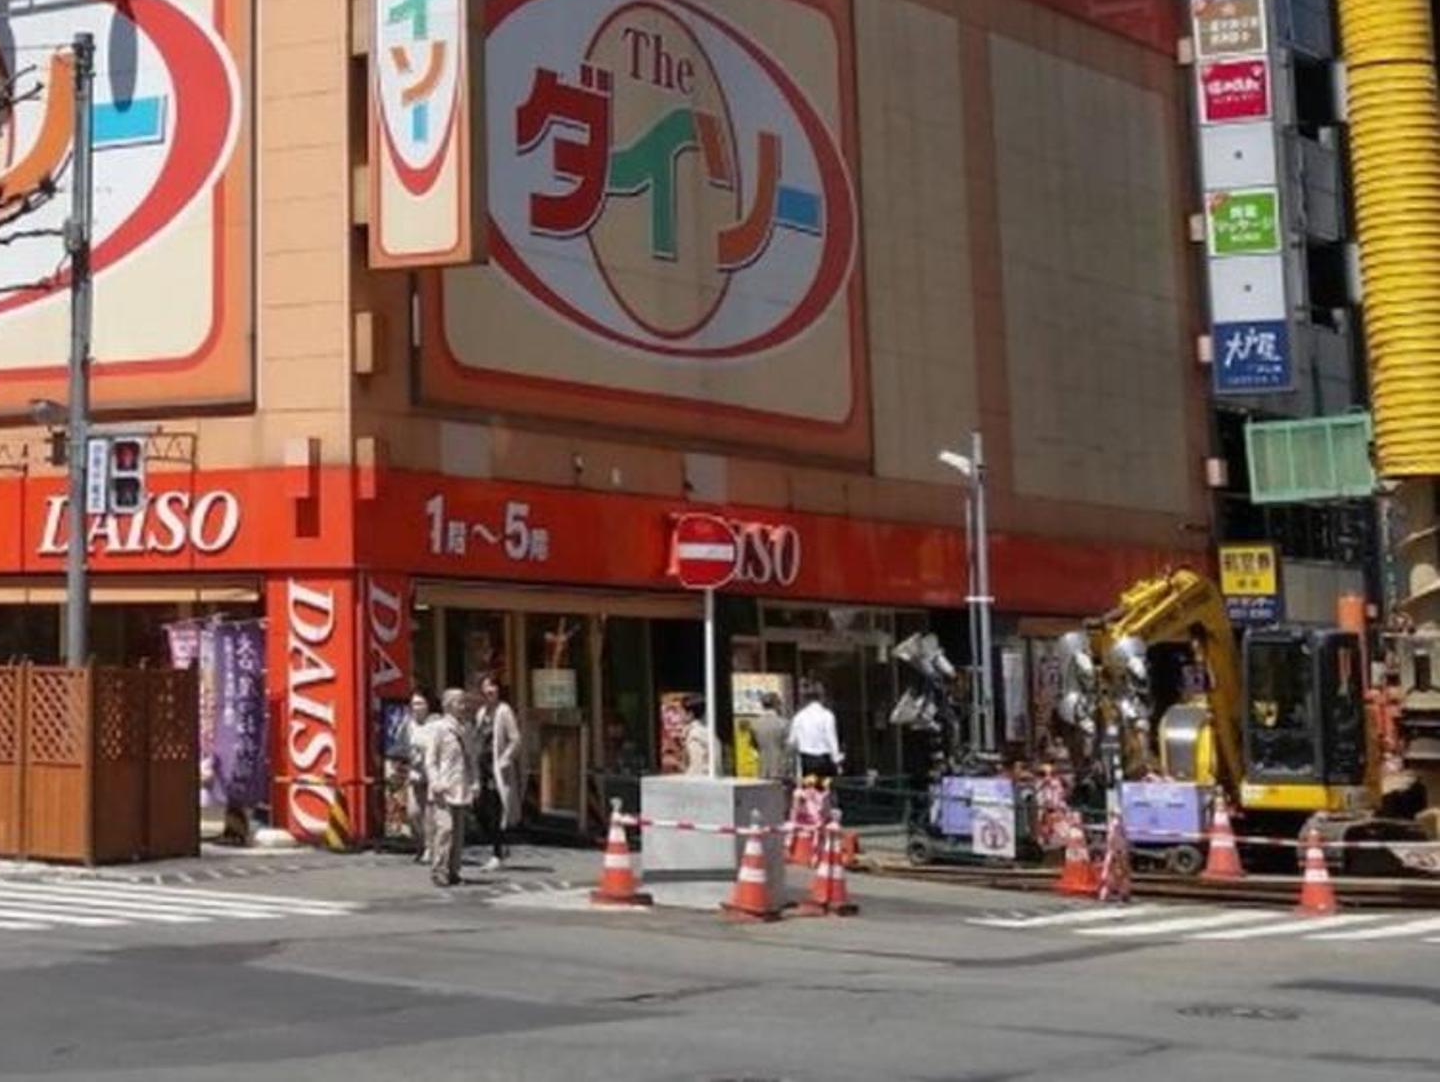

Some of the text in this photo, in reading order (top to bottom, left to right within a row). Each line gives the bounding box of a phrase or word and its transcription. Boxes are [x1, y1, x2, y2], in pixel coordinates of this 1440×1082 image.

[622, 27, 695, 96] The
[515, 63, 823, 272] ダイソー
[288, 577, 337, 834] DAISO
